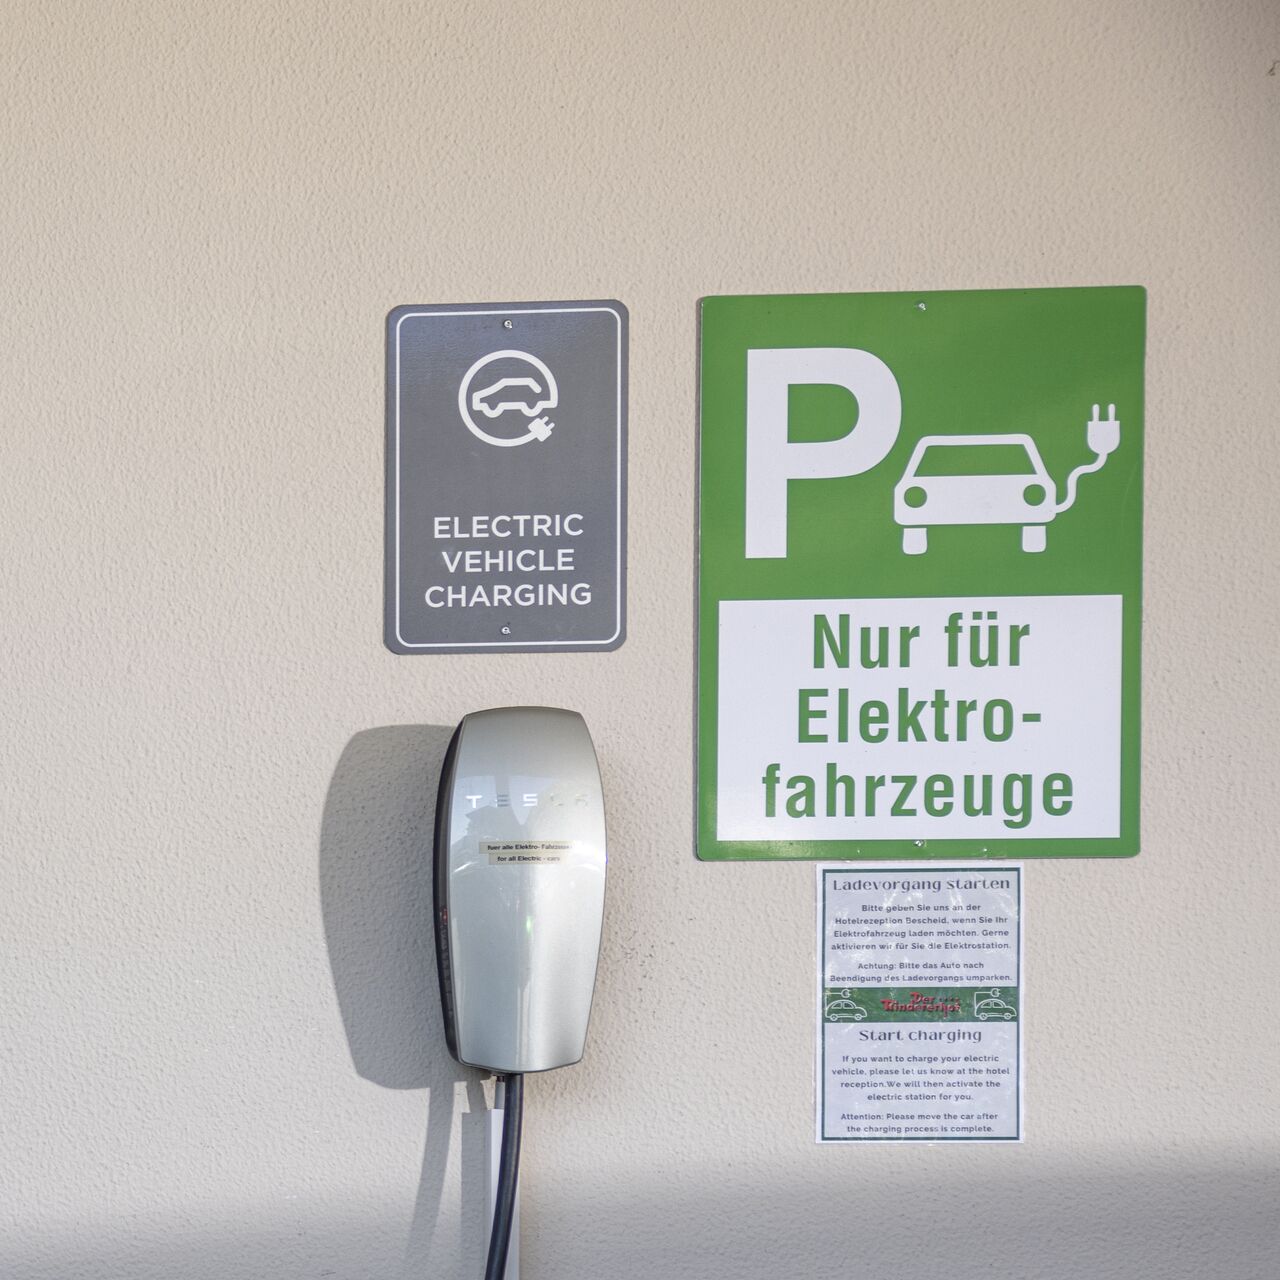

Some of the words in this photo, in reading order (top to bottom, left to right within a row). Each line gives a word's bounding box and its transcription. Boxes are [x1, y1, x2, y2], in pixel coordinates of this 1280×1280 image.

[745, 348, 902, 559] P
[434, 513, 584, 538] ELECTRIC
[442, 549, 574, 573] VEHICLE
[425, 583, 591, 608] CHARGING
[813, 614, 920, 669] Nur
[944, 611, 1030, 668] für
[798, 688, 1041, 743] Elektro-
[762, 763, 1073, 829] fahrzeuge
[833, 879, 941, 893] Ladevorgang
[947, 878, 1010, 890] starten
[886, 905, 914, 913] geben
[835, 918, 902, 926] Hotelrezeption
[834, 930, 906, 938] Elektrofahrzeug
[858, 963, 896, 971] Achtung:
[830, 975, 881, 983] Beendigung
[903, 974, 963, 982] Ladevorgangs
[860, 1030, 903, 1041] Start
[908, 1029, 982, 1043] charging
[907, 1055, 938, 1063] charge
[870, 1068, 899, 1076] please
[864, 1125, 901, 1133] charging
[951, 1125, 994, 1133] complete.
